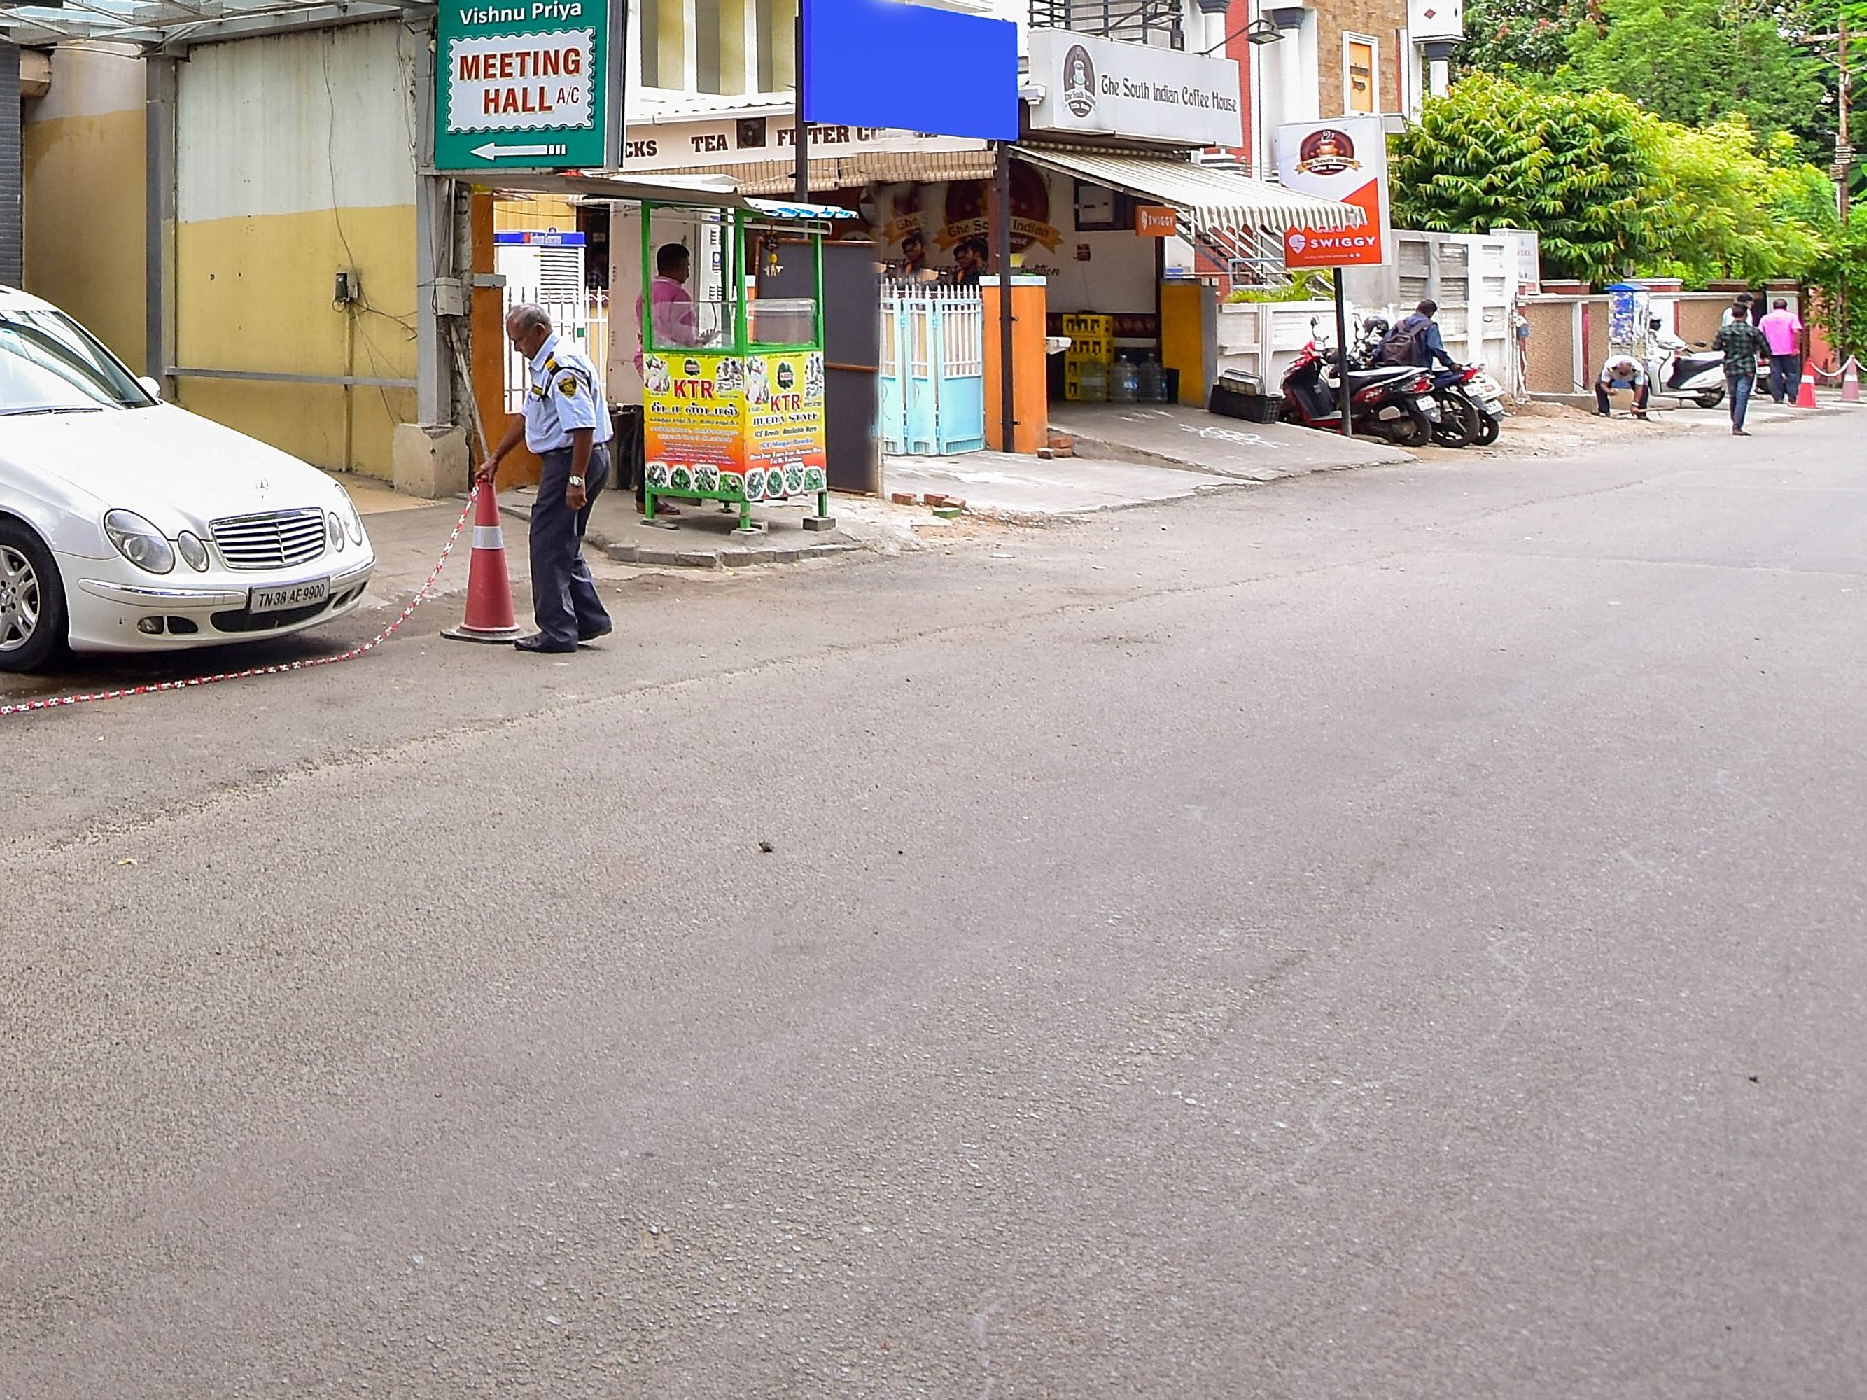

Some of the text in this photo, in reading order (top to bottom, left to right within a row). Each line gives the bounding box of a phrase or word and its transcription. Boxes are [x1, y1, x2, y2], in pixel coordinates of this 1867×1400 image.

[460, 0, 583, 25] Vishnu Priya
[459, 48, 582, 81] MEETING
[484, 86, 580, 114] HALL A/C
[1101, 75, 1237, 112] The South Indian Coffee House
[691, 134, 728, 153] TEA
[777, 126, 850, 147] FITER
[1310, 236, 1376, 249] SWIGGY
[674, 379, 714, 399] KTR
[770, 394, 802, 411] KTR
